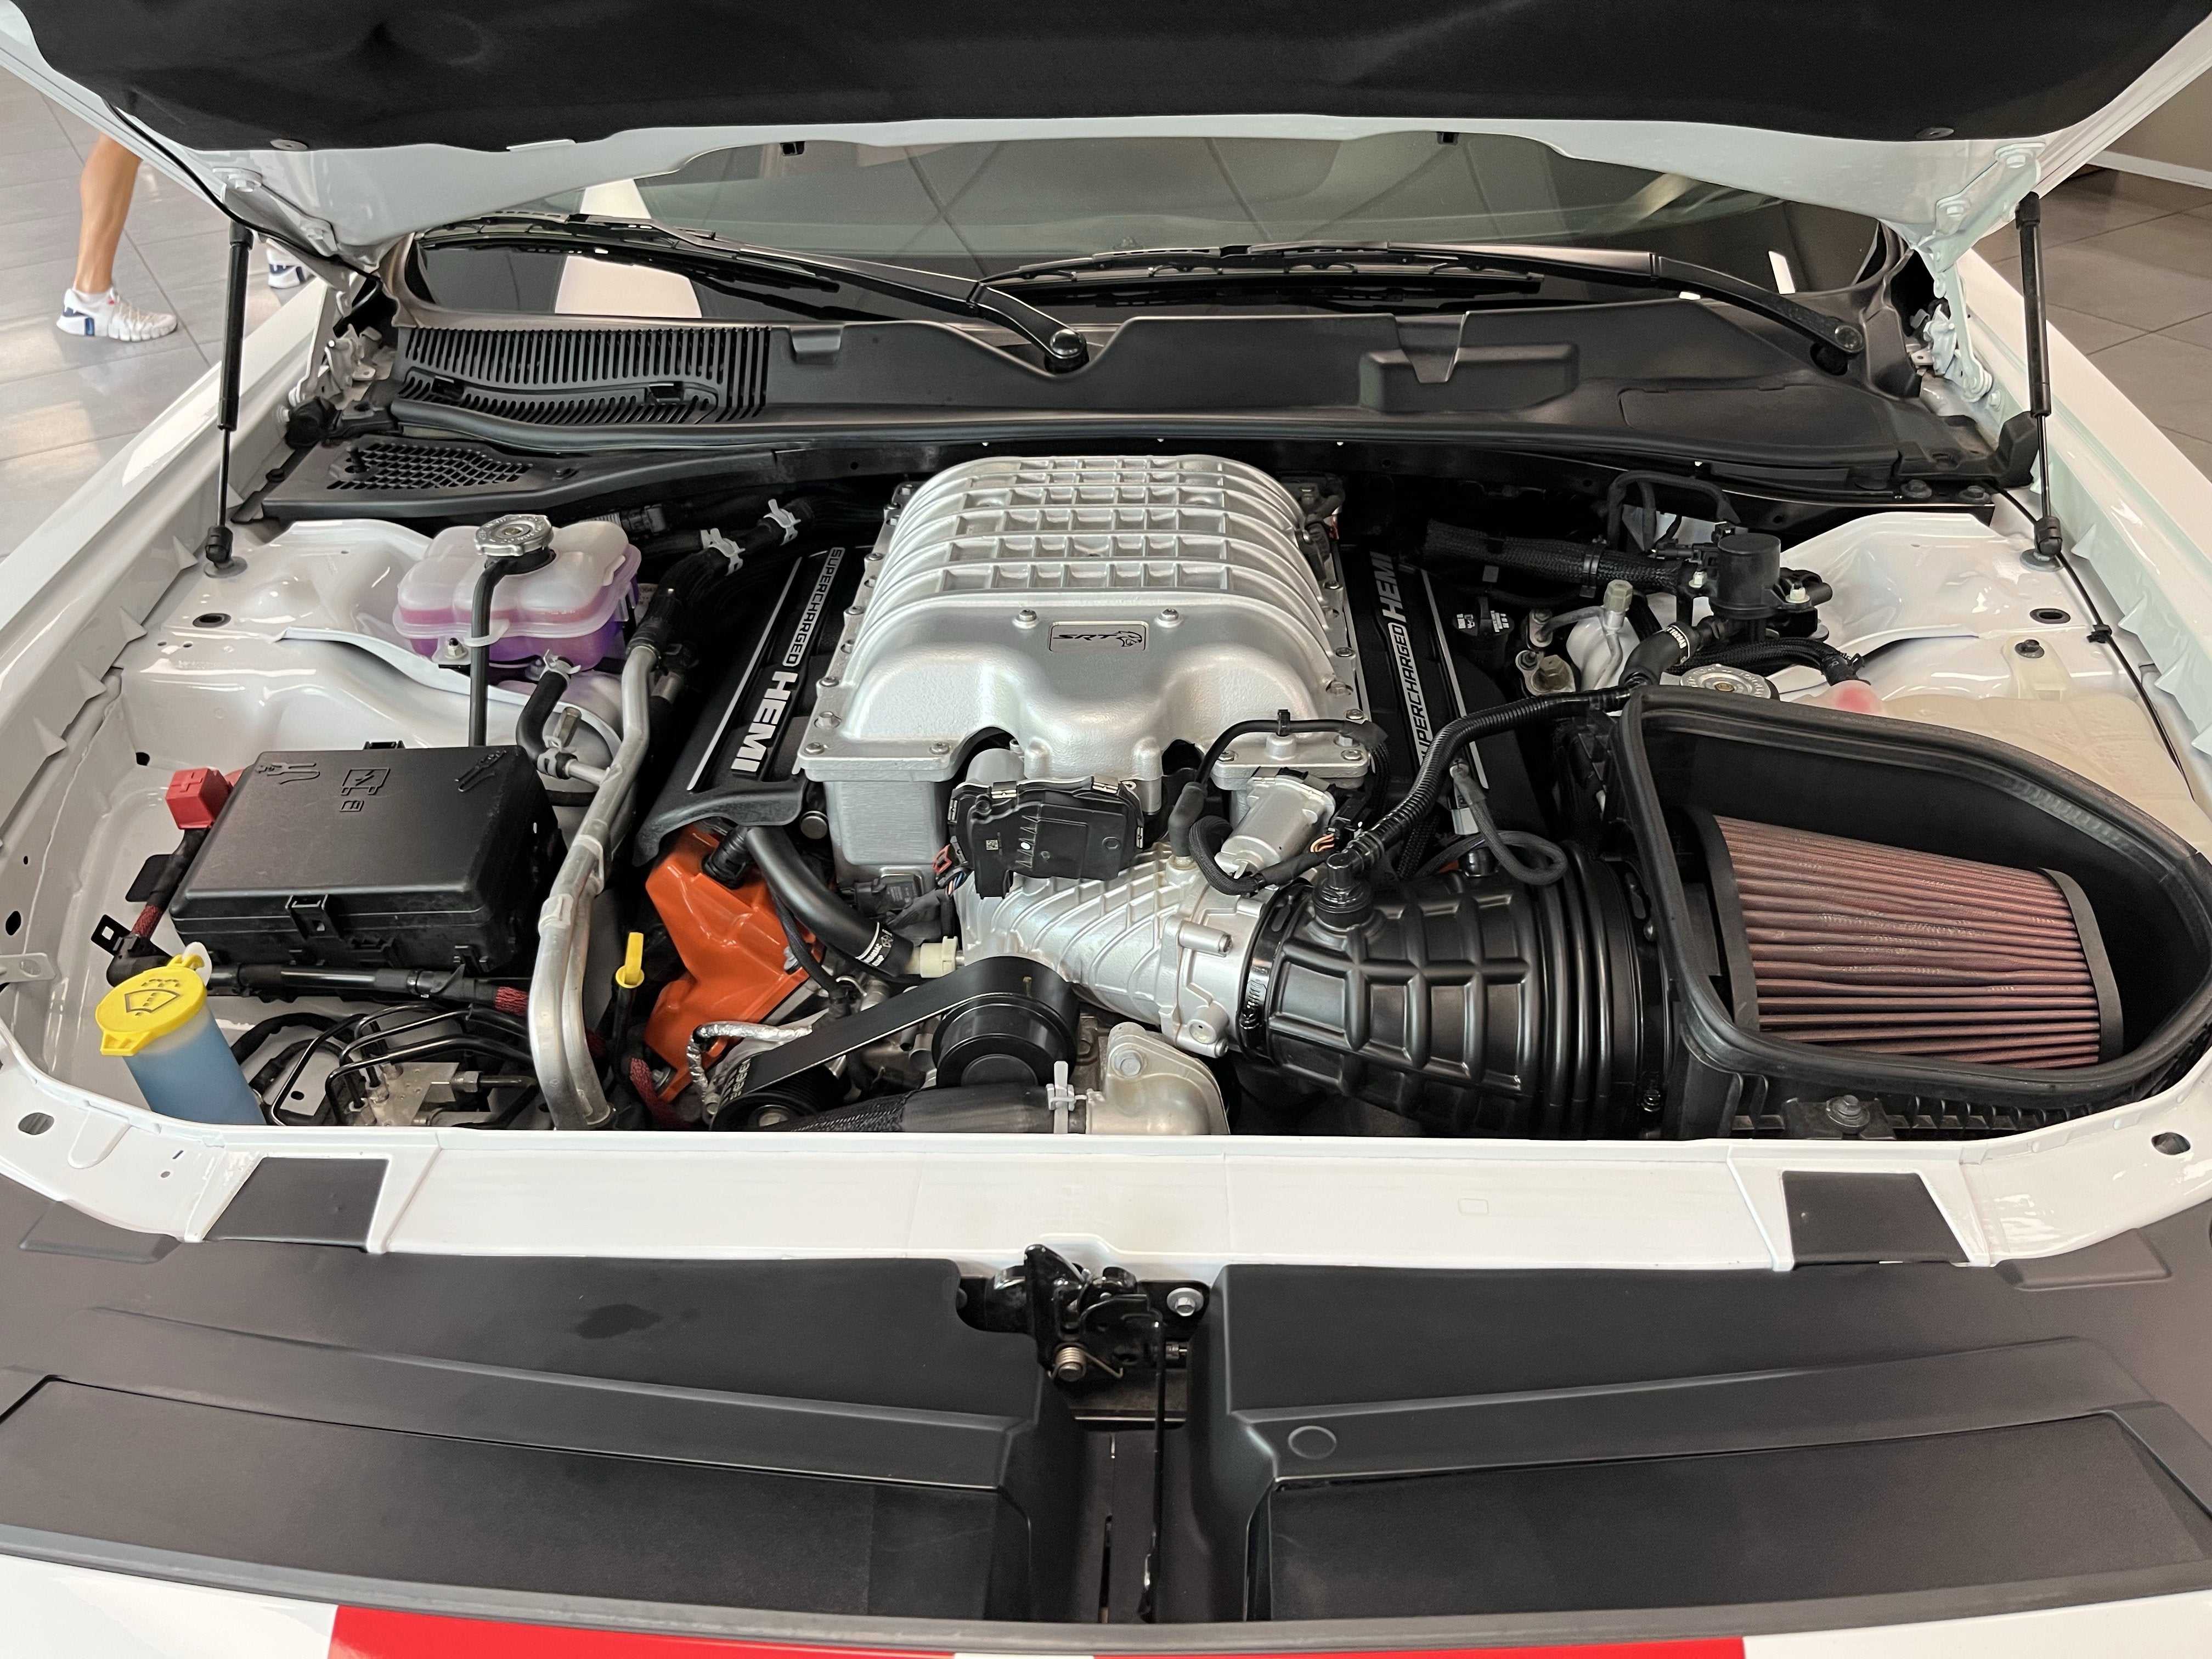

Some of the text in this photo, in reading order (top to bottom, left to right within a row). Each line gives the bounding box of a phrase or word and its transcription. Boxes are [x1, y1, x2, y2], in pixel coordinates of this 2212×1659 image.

[731, 548, 844, 772] SUPERCHARGED HEMI
[1370, 551, 1432, 760] UPERCHARGED HEMI
